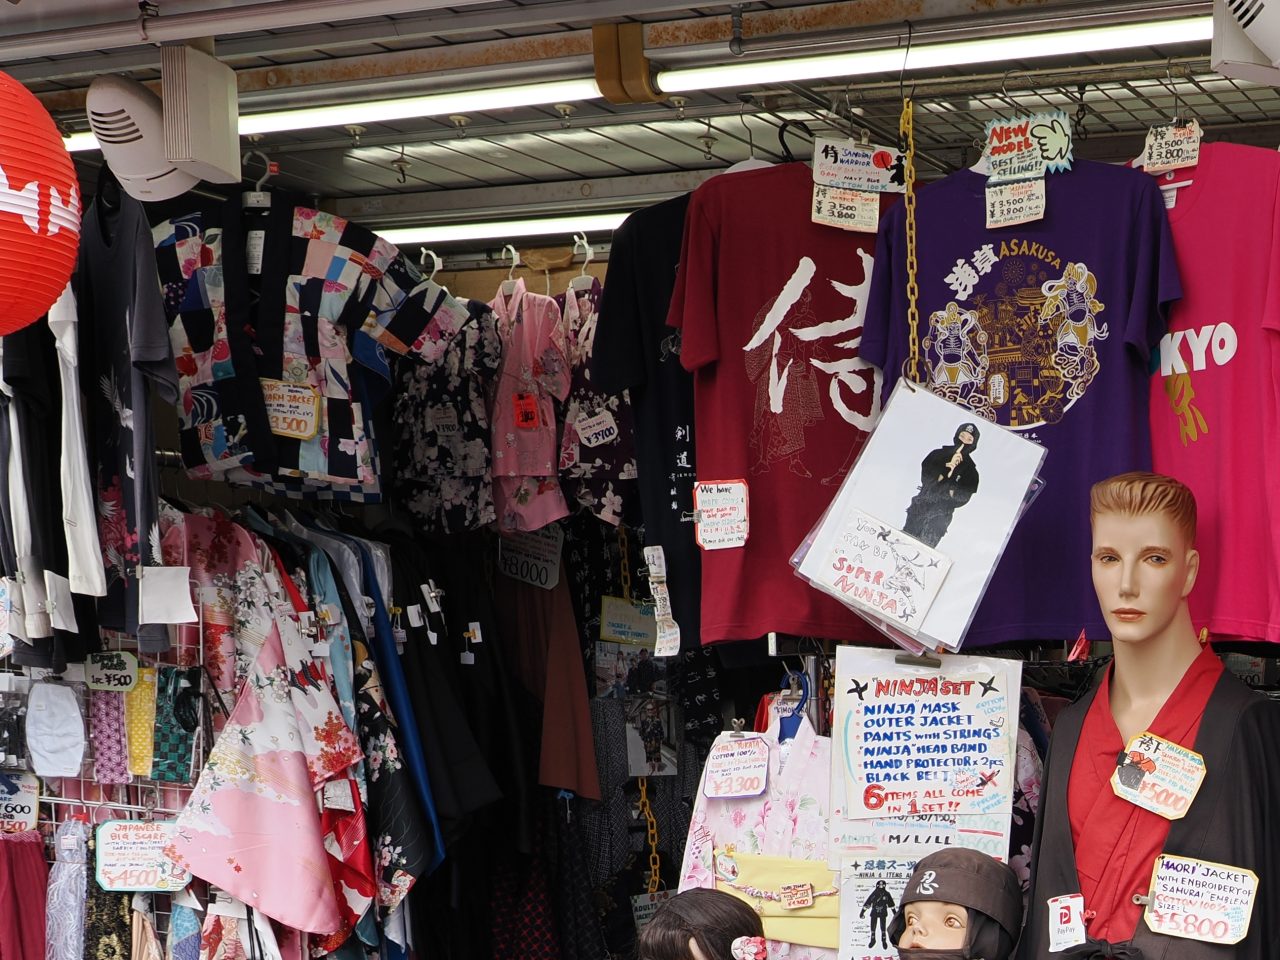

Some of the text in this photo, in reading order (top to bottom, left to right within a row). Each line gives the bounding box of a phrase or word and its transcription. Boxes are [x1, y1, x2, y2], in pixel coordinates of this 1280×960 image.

[989, 121, 1029, 144] NEW
[990, 137, 1033, 156] MODEL
[821, 144, 838, 164] 侍
[992, 157, 1014, 169] BEST
[1000, 239, 1061, 270] ASAKUSA
[743, 248, 882, 432] 侍
[1160, 322, 1237, 376] KYO
[675, 425, 692, 468] 剣道
[717, 485, 732, 493] have
[873, 545, 888, 559] BE
[833, 557, 884, 586] SUPER
[833, 575, 897, 614] NINJA
[105, 674, 133, 687] ¥500
[940, 680, 976, 696] SET
[921, 702, 960, 714] MASK
[864, 714, 974, 728] OUTER JACKET
[864, 728, 1000, 742] PANTS STRINGS
[916, 743, 988, 754] HEAD BAND
[712, 752, 735, 760] COTTON
[864, 757, 971, 769] HAND PROTECTOR
[866, 772, 910, 783] BLACK
[917, 771, 950, 782] BELT
[863, 784, 984, 810] 6 ITEMS ALL COME
[888, 800, 920, 814] IN 1
[115, 823, 162, 831] JAPANESE
[1157, 875, 1178, 883] WITH
[1201, 867, 1248, 883] JACKET
[916, 870, 939, 895] 忍
[1156, 893, 1229, 911] COTTON 100%
[1210, 893, 1248, 906] EMBLEM
[634, 903, 658, 912] ADULTS
[1158, 903, 1189, 914] SIZE: L
[1057, 926, 1075, 935] PayPay
